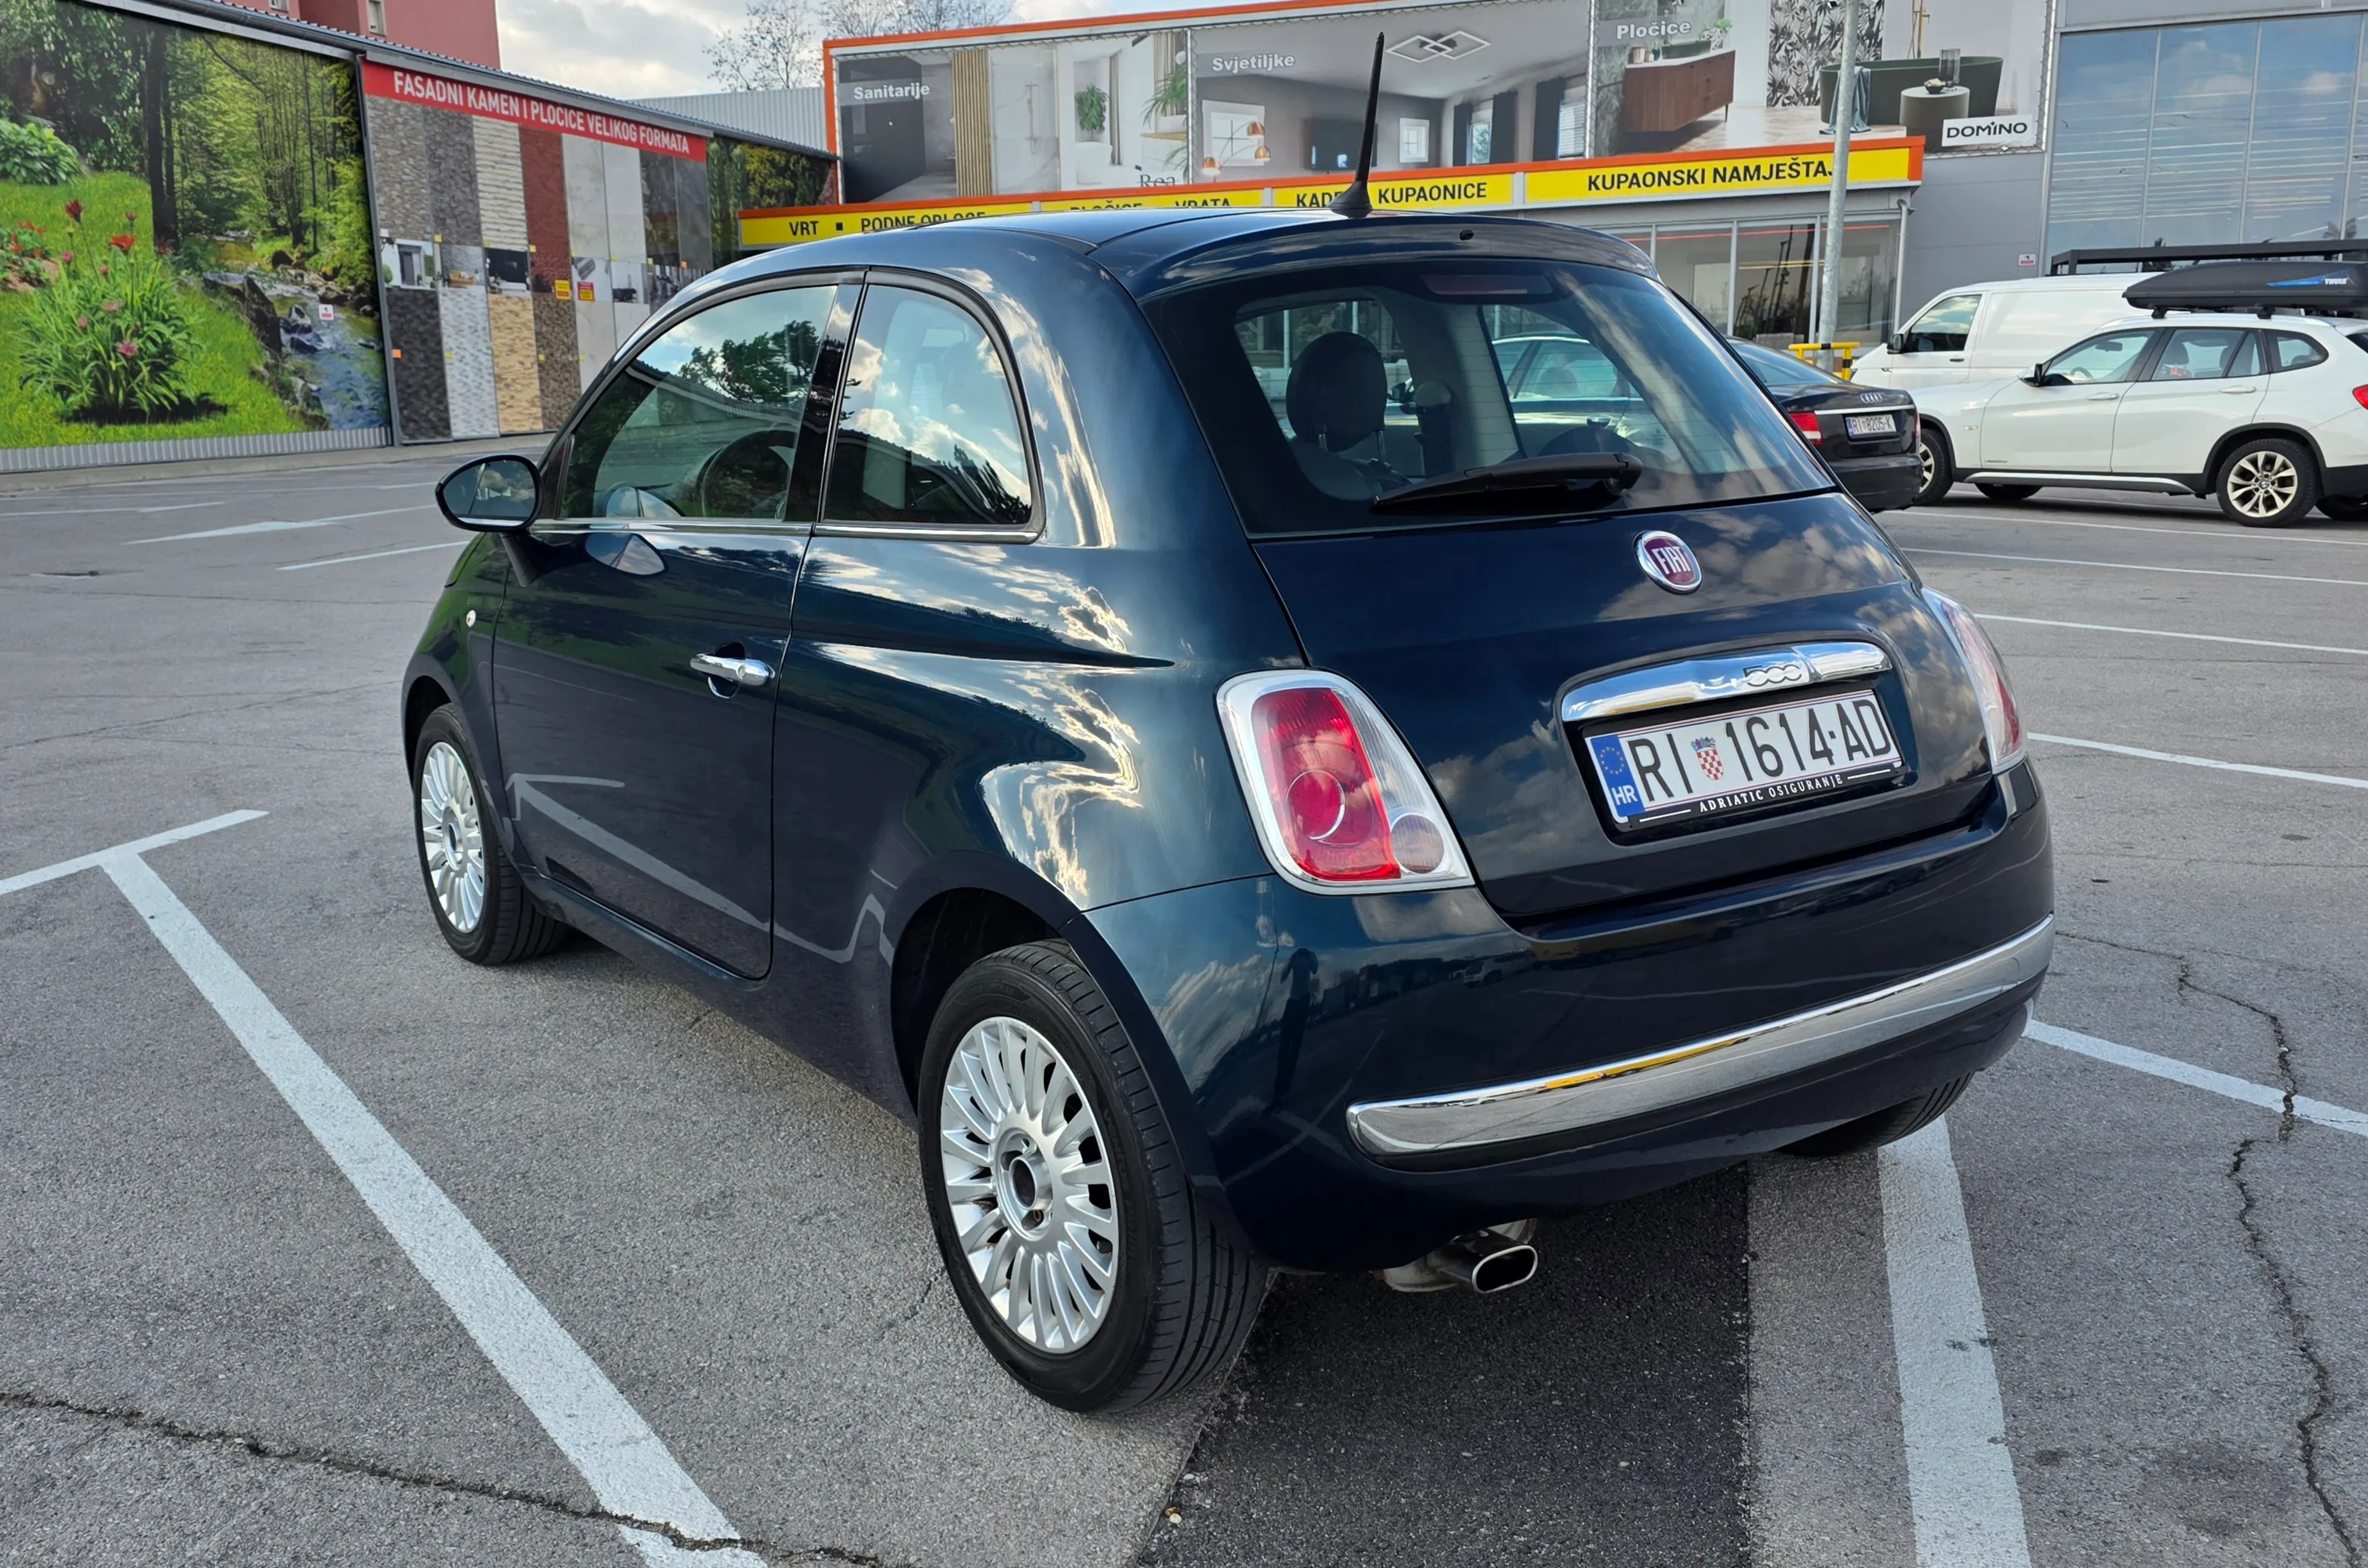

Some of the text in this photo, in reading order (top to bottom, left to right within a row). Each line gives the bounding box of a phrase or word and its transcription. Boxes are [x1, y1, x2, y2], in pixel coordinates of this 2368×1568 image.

[1616, 20, 1692, 40] Pločice
[1212, 53, 1295, 74] Svjetiljke
[854, 82, 930, 100] Sanitarije
[392, 70, 463, 107] FASADNI
[466, 86, 520, 118] KAMEN
[522, 98, 528, 120] I
[587, 113, 637, 143] VELIKOG
[640, 126, 690, 155] FORMATA
[1588, 156, 1833, 191] KUPAONSKI NAMJEŠTA
[1378, 182, 1487, 204] KUPAONICE
[789, 221, 819, 236] VRT
[1852, 420, 1863, 432] RI
[1650, 546, 1691, 575] FIAT
[1743, 664, 1802, 687] 500
[1628, 733, 1694, 803] RI
[1611, 784, 1638, 806] HR
[1700, 773, 1843, 813] ADRIATIC OSIGURANJE
